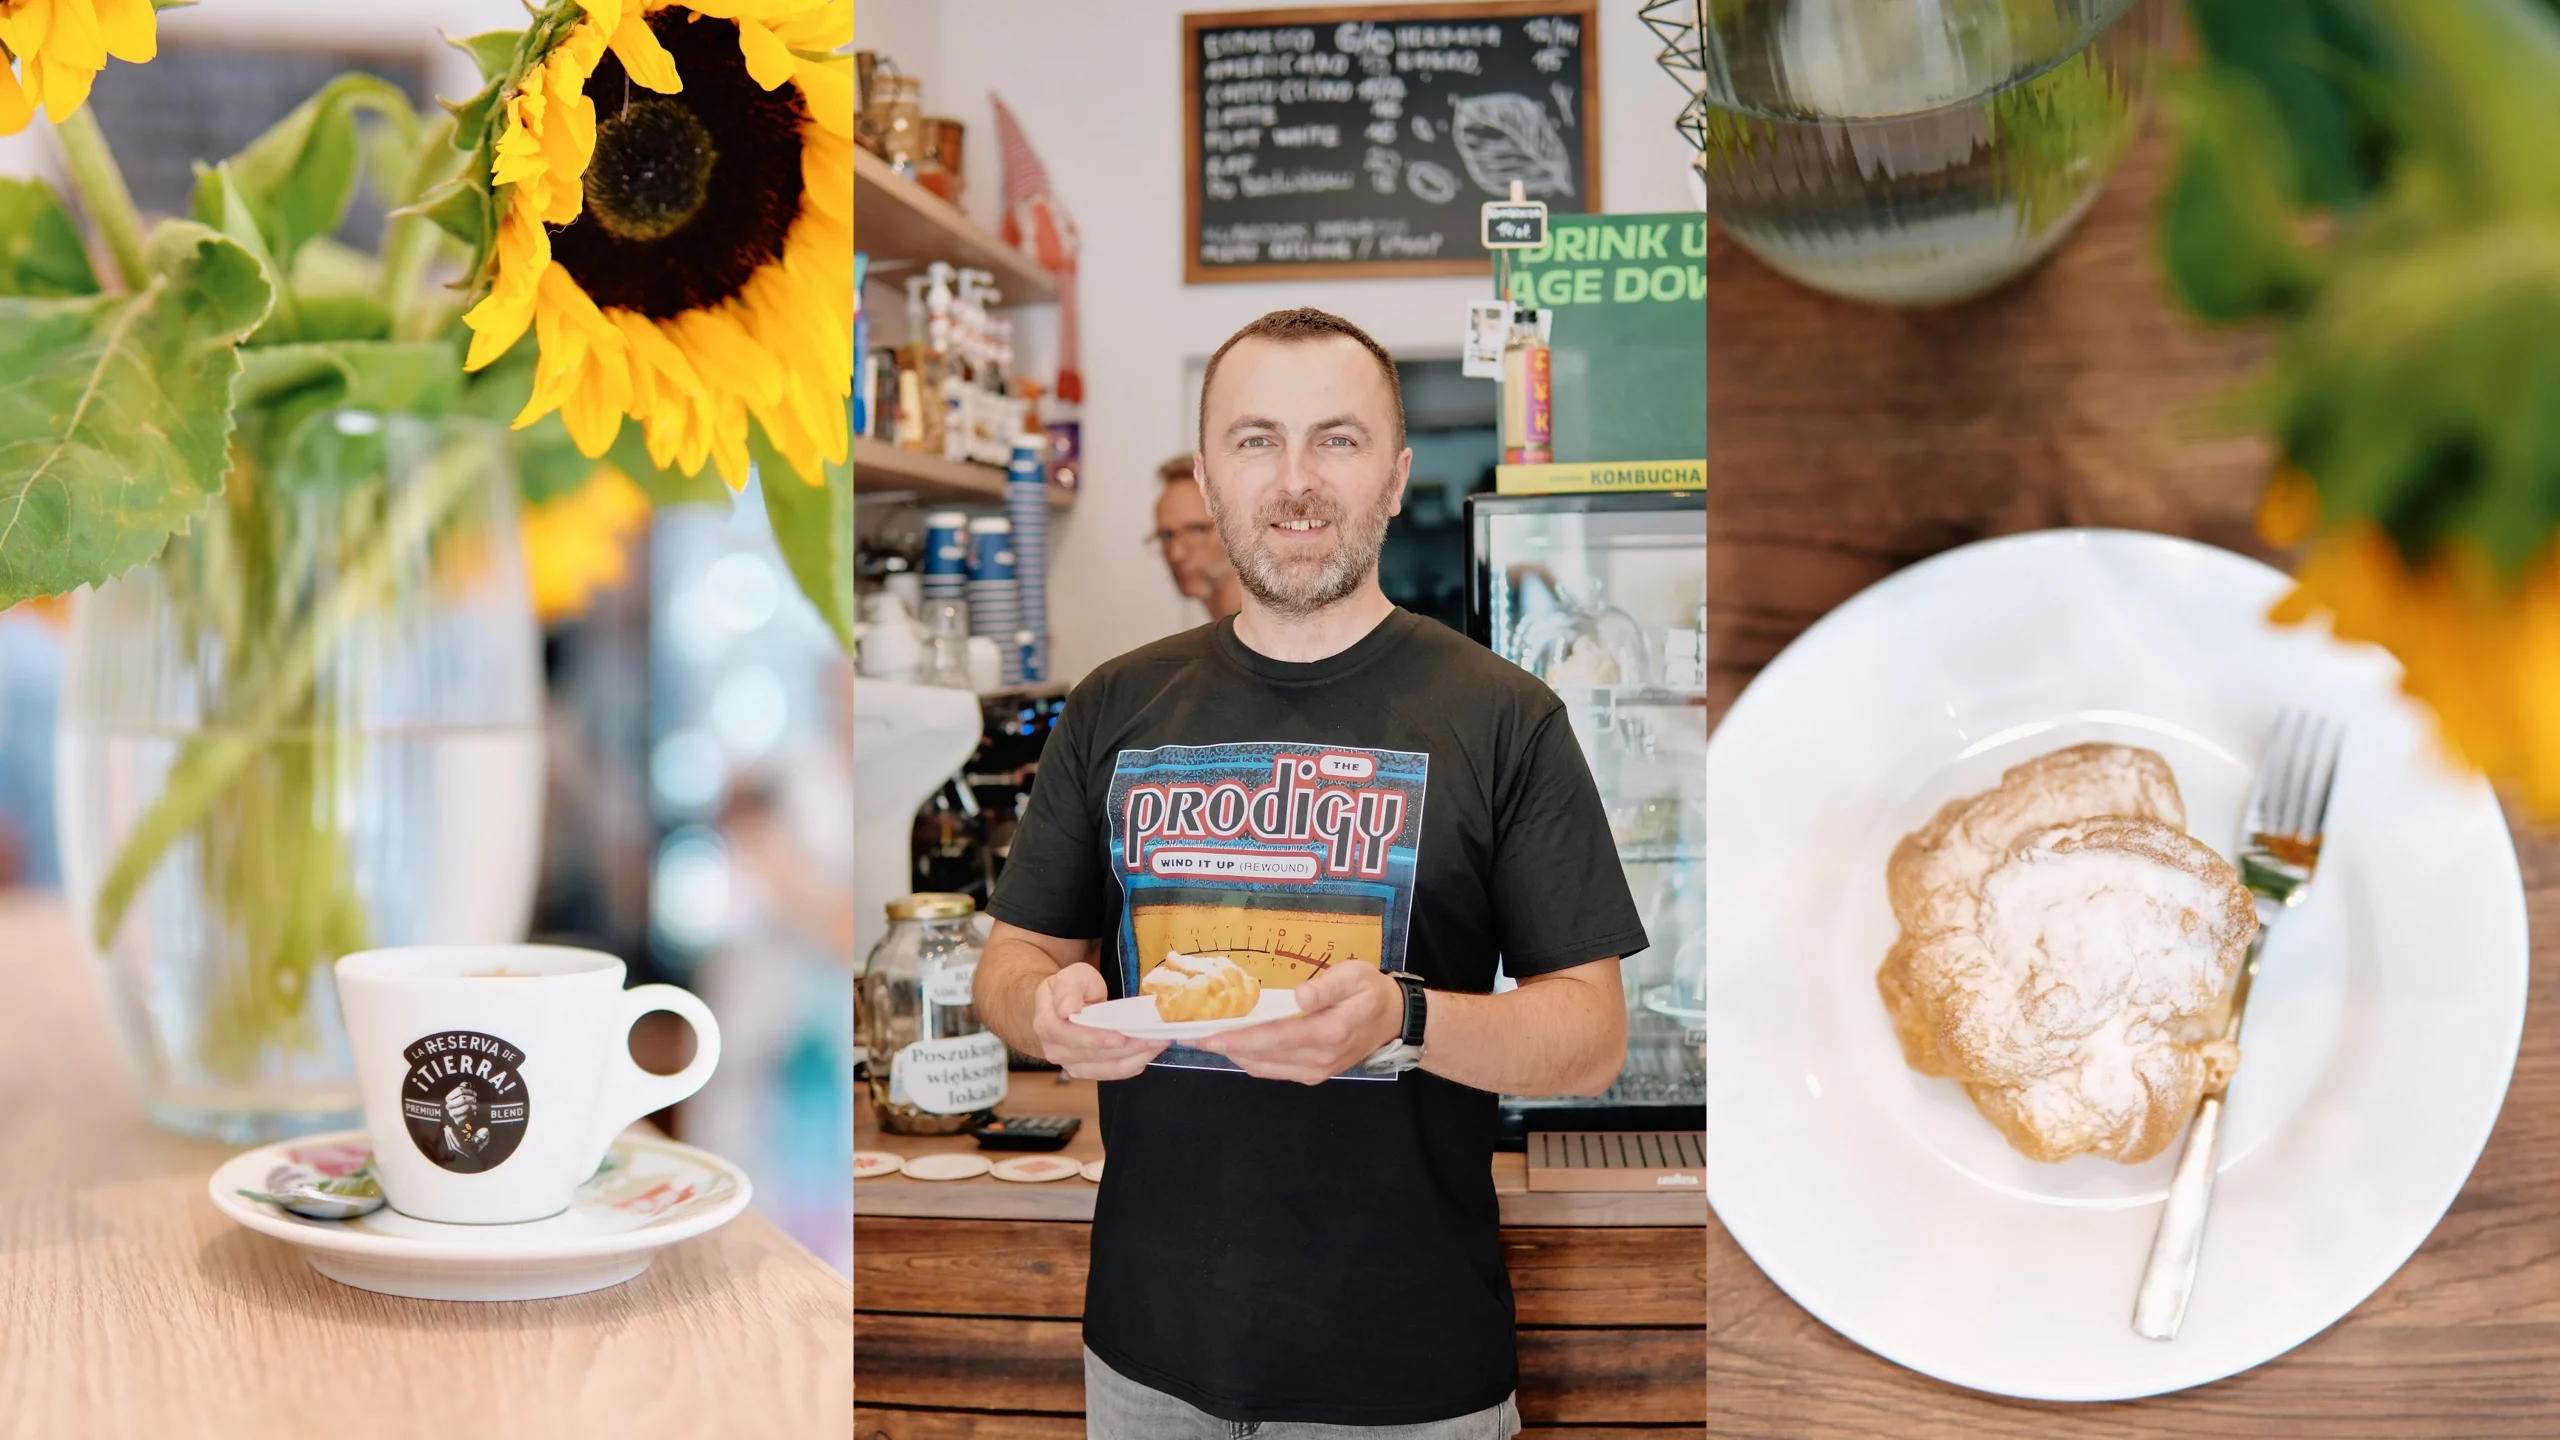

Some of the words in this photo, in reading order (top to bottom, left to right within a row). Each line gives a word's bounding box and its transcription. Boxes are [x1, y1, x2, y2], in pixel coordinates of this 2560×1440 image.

[1519, 224, 1671, 263] DRINK
[1510, 268, 1604, 309] AGE
[1590, 468, 1702, 486] KOMBUCHA
[1332, 761, 1360, 771] THE
[1161, 859, 1193, 868] WIND
[1198, 860, 1211, 868] IT
[1216, 861, 1235, 870] UP
[1239, 862, 1309, 874] (REWOUND)
[411, 1047, 425, 1060] LA
[424, 1035, 499, 1057] RESERVA
[502, 1049, 517, 1062] DE
[405, 1103, 442, 1117] PREMIUM
[490, 1108, 524, 1119] BLEND
